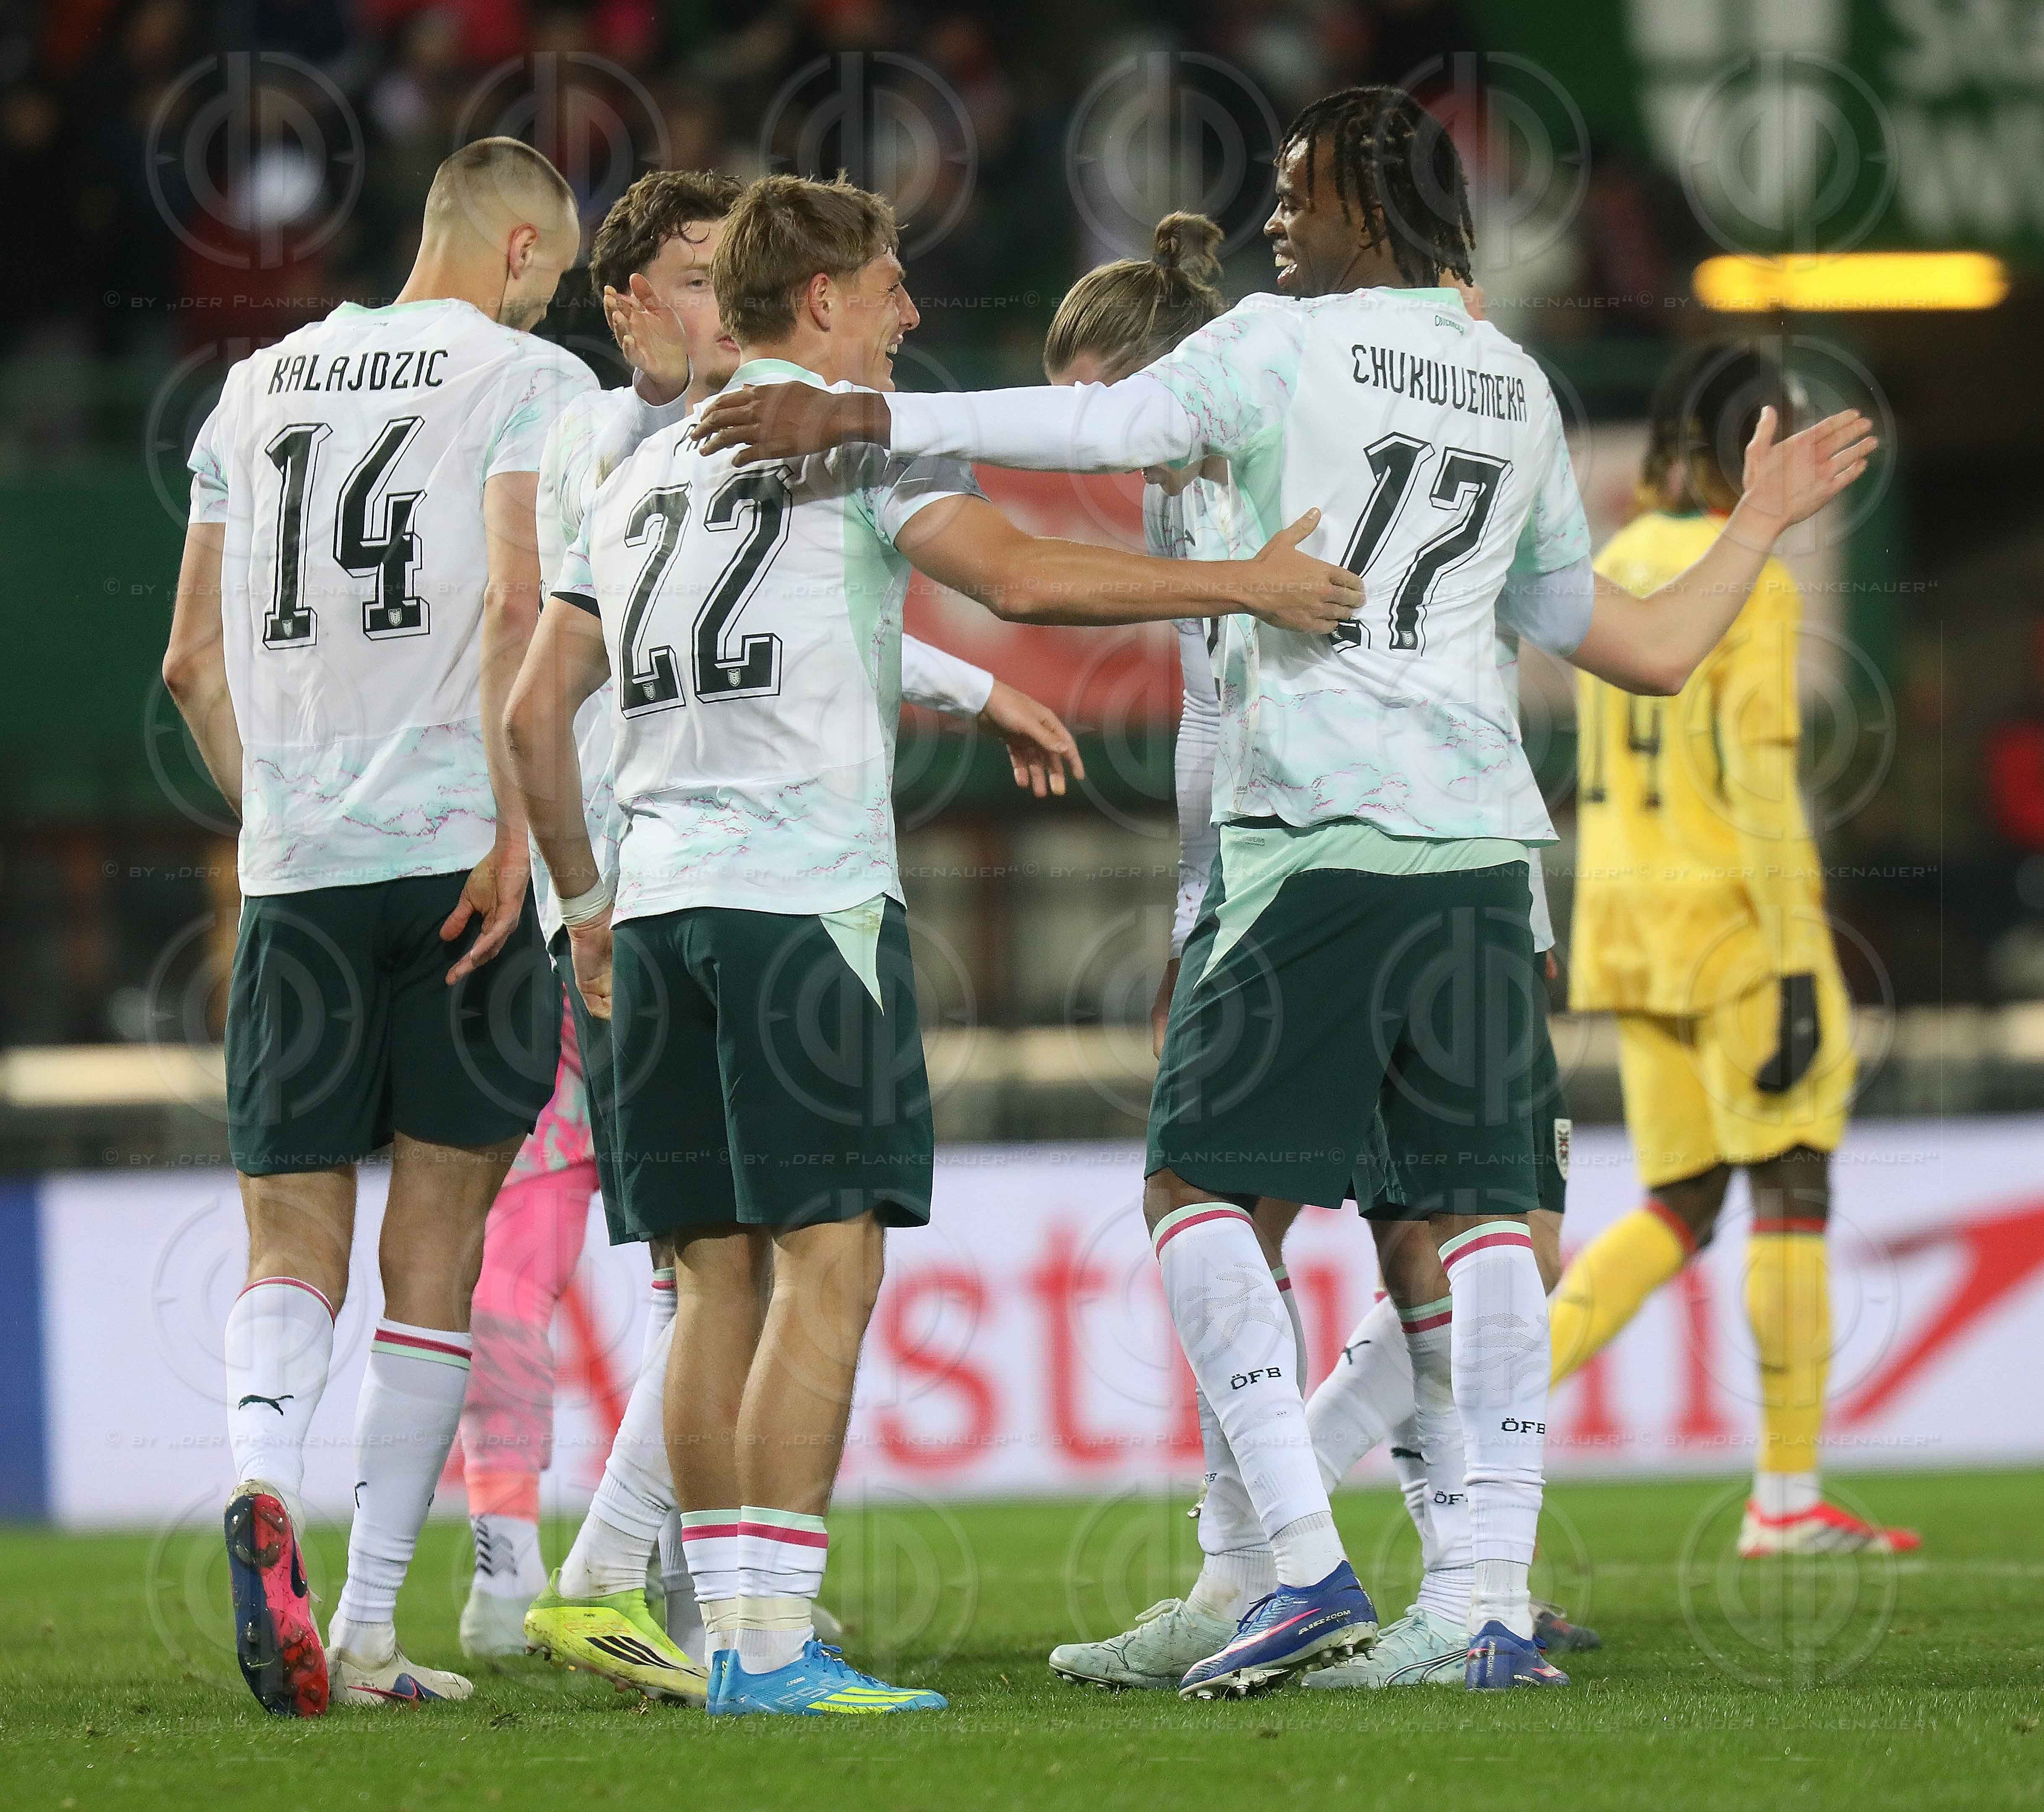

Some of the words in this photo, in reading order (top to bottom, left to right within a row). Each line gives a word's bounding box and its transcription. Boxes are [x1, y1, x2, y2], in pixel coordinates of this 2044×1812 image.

[268, 349, 448, 395] KALAJDZIC
[1351, 344, 1528, 423] CHUKWUEMEKA
[262, 416, 430, 650] 14
[1331, 432, 1513, 657] 17
[620, 464, 794, 719] 22
[1230, 1367, 1282, 1390] ÖFB
[1501, 1417, 1545, 1434] ÖFB
[1433, 1490, 1468, 1505] ÖF
